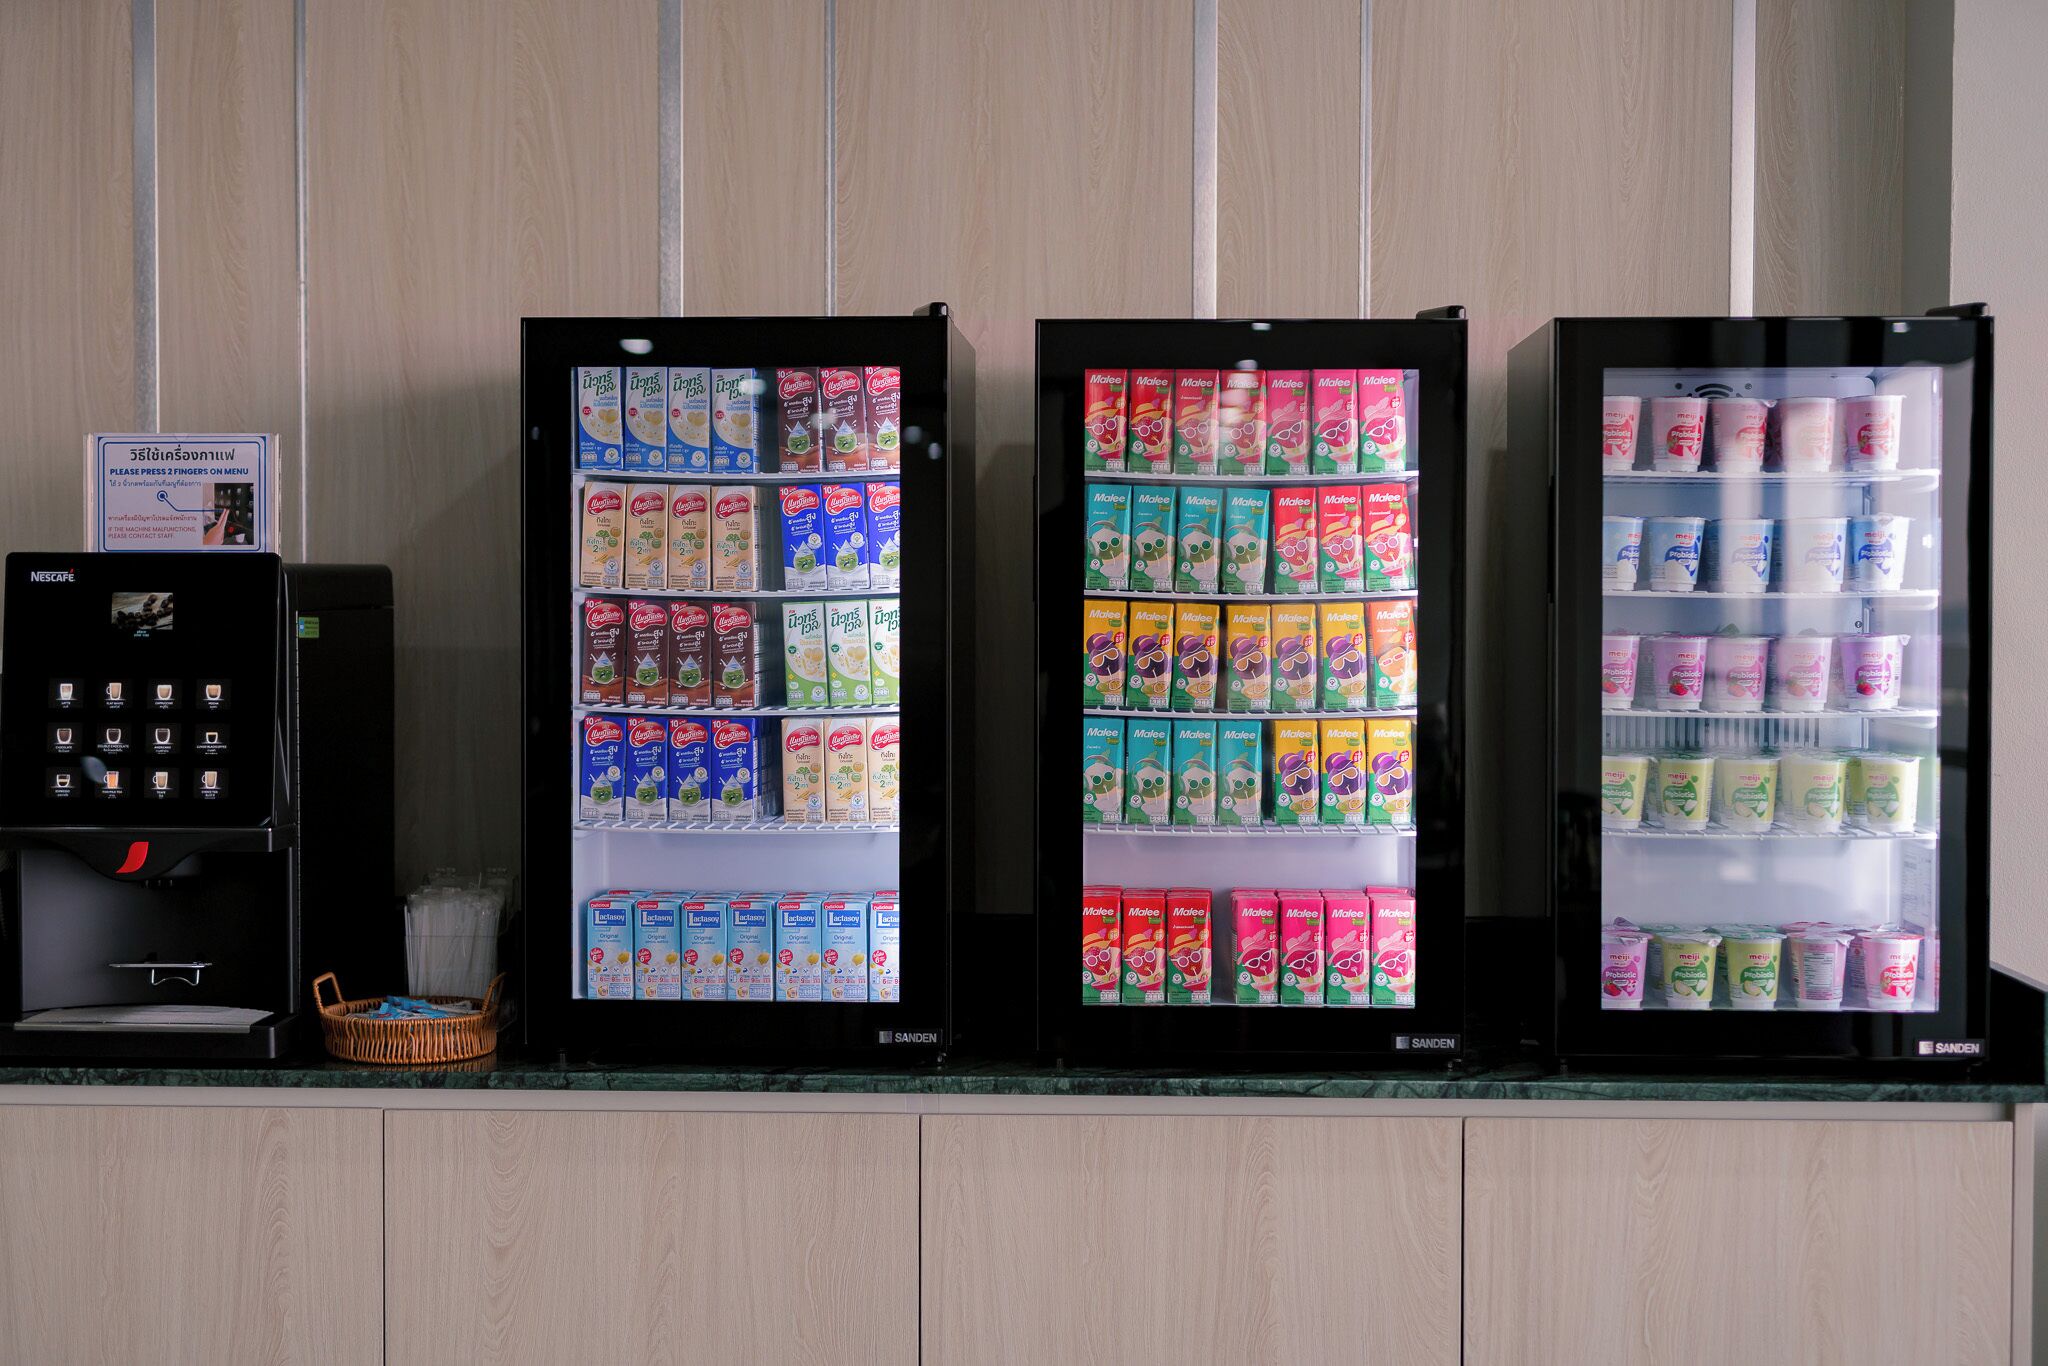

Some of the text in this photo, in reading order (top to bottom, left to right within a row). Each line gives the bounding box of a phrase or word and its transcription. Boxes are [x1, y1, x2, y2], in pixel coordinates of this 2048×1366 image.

[1090, 375, 1122, 384] Malee
[1137, 377, 1168, 386] Malee
[1181, 378, 1213, 387] Malee
[1272, 379, 1303, 388] Malee
[1319, 378, 1350, 387] Malee
[1363, 376, 1396, 385] Malee
[130, 444, 235, 461] วิธีใช้เครื่องกาแฟ
[1094, 493, 1125, 502] Malee
[1139, 495, 1170, 504] Malee
[1186, 496, 1217, 505] Malee
[1232, 497, 1263, 506] Malee
[1279, 498, 1311, 506] Malee
[1324, 495, 1356, 504] Malee
[1369, 493, 1401, 502] Malee
[1669, 551, 1698, 559] Probiotic
[31, 569, 75, 582] NESCAFÉ
[586, 600, 594, 608] 10
[630, 602, 638, 610] 10
[1089, 610, 1121, 619] Malee
[1136, 611, 1167, 621] Malee
[1181, 613, 1213, 622] Malee
[1233, 614, 1264, 623] Malee
[1278, 614, 1309, 622] Malee
[1327, 613, 1358, 622] Malee
[1377, 611, 1409, 619] Malee
[1087, 728, 1118, 736] Malee
[1134, 729, 1165, 738] Malee
[1180, 730, 1211, 739] Malee
[1224, 731, 1256, 739] Malee
[1280, 729, 1312, 738] Malee
[1327, 729, 1358, 737] Malee
[1374, 729, 1405, 737] Malee
[1083, 907, 1114, 915] Malee
[1128, 908, 1160, 916] Malee
[1173, 908, 1204, 916] Malee
[1242, 908, 1273, 917] Malee
[1286, 909, 1319, 918] Malee
[1332, 909, 1364, 918] Malee
[1378, 909, 1411, 918] Malee
[595, 910, 624, 924] Lactasoy
[642, 911, 672, 925] Lactasoy
[689, 912, 720, 926] Lactasoy
[735, 911, 765, 924] Lactasoy
[784, 912, 815, 926] Lactasoy
[829, 912, 859, 925] Lactasoy
[895, 1033, 936, 1042] SANDEN
[1412, 1039, 1454, 1048] SANDEN
[1936, 1043, 1980, 1053] SANDEN
